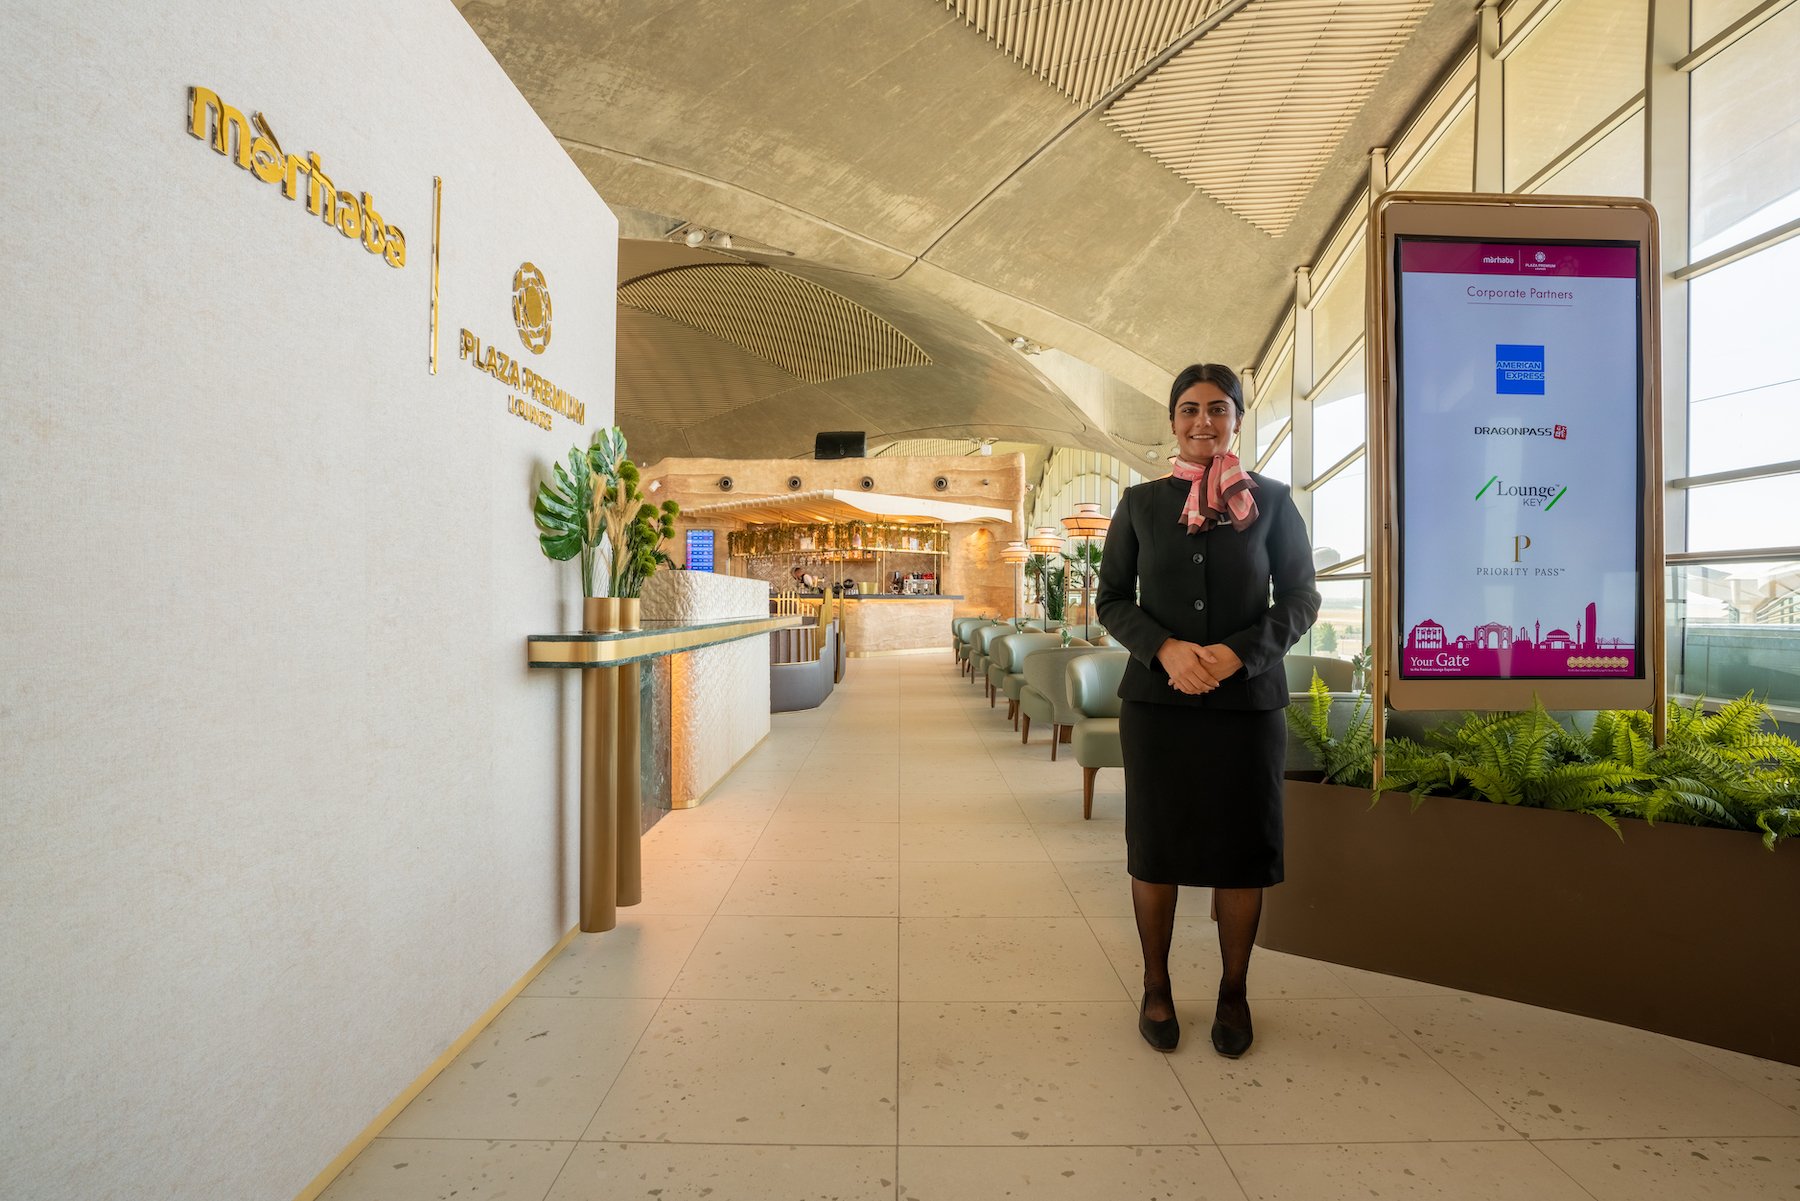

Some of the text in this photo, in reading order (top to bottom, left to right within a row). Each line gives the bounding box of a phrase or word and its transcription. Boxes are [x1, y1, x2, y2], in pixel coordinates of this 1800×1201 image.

[1467, 285, 1573, 300] Corporate Partners
[1496, 360, 1542, 371] AMERICAN
[459, 328, 584, 426] PLAZA PREMIUM
[1505, 370, 1545, 381] EXPRESS
[507, 394, 552, 431] LOUNGE
[1474, 426, 1552, 437] DRAGONPASS
[1523, 498, 1543, 507] KEY
[1476, 567, 1529, 577] PRIORITY
[1410, 652, 1470, 667] Your Gate
